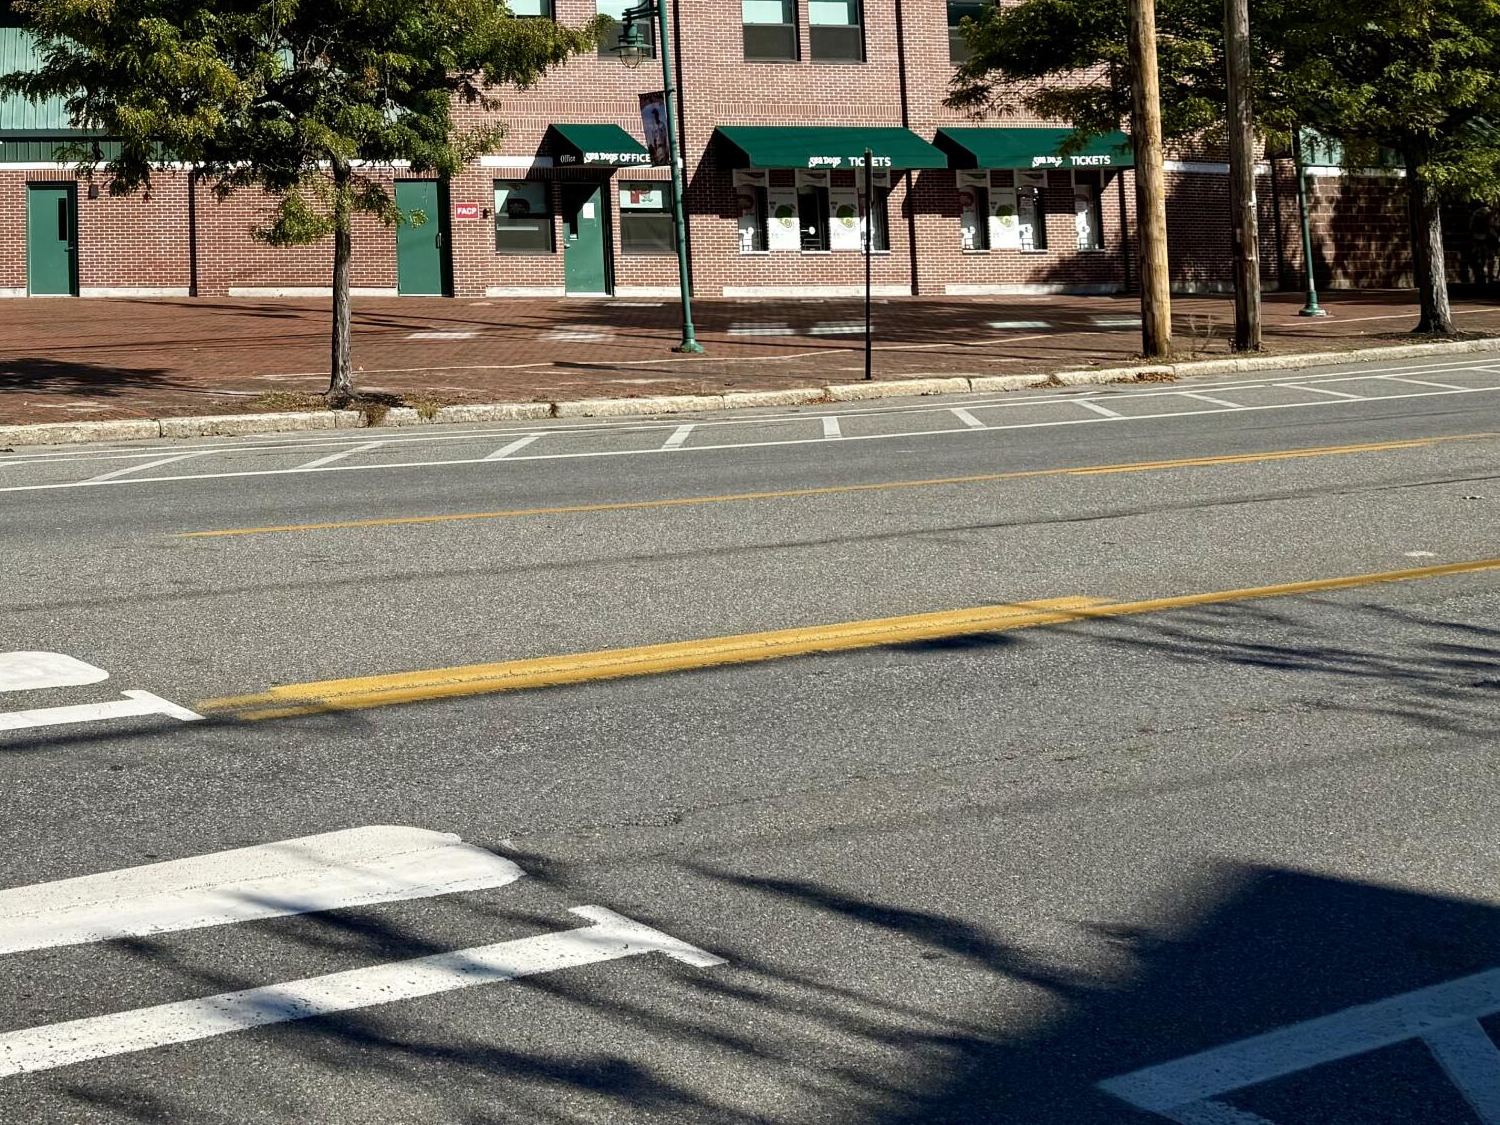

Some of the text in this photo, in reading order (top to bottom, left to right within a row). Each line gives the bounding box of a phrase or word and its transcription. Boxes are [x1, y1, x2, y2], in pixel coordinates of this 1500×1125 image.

[619, 153, 651, 163] OFFICE
[848, 156, 891, 167] TICETS
[1070, 155, 1111, 166] TICKETS
[457, 207, 477, 215] FACP
